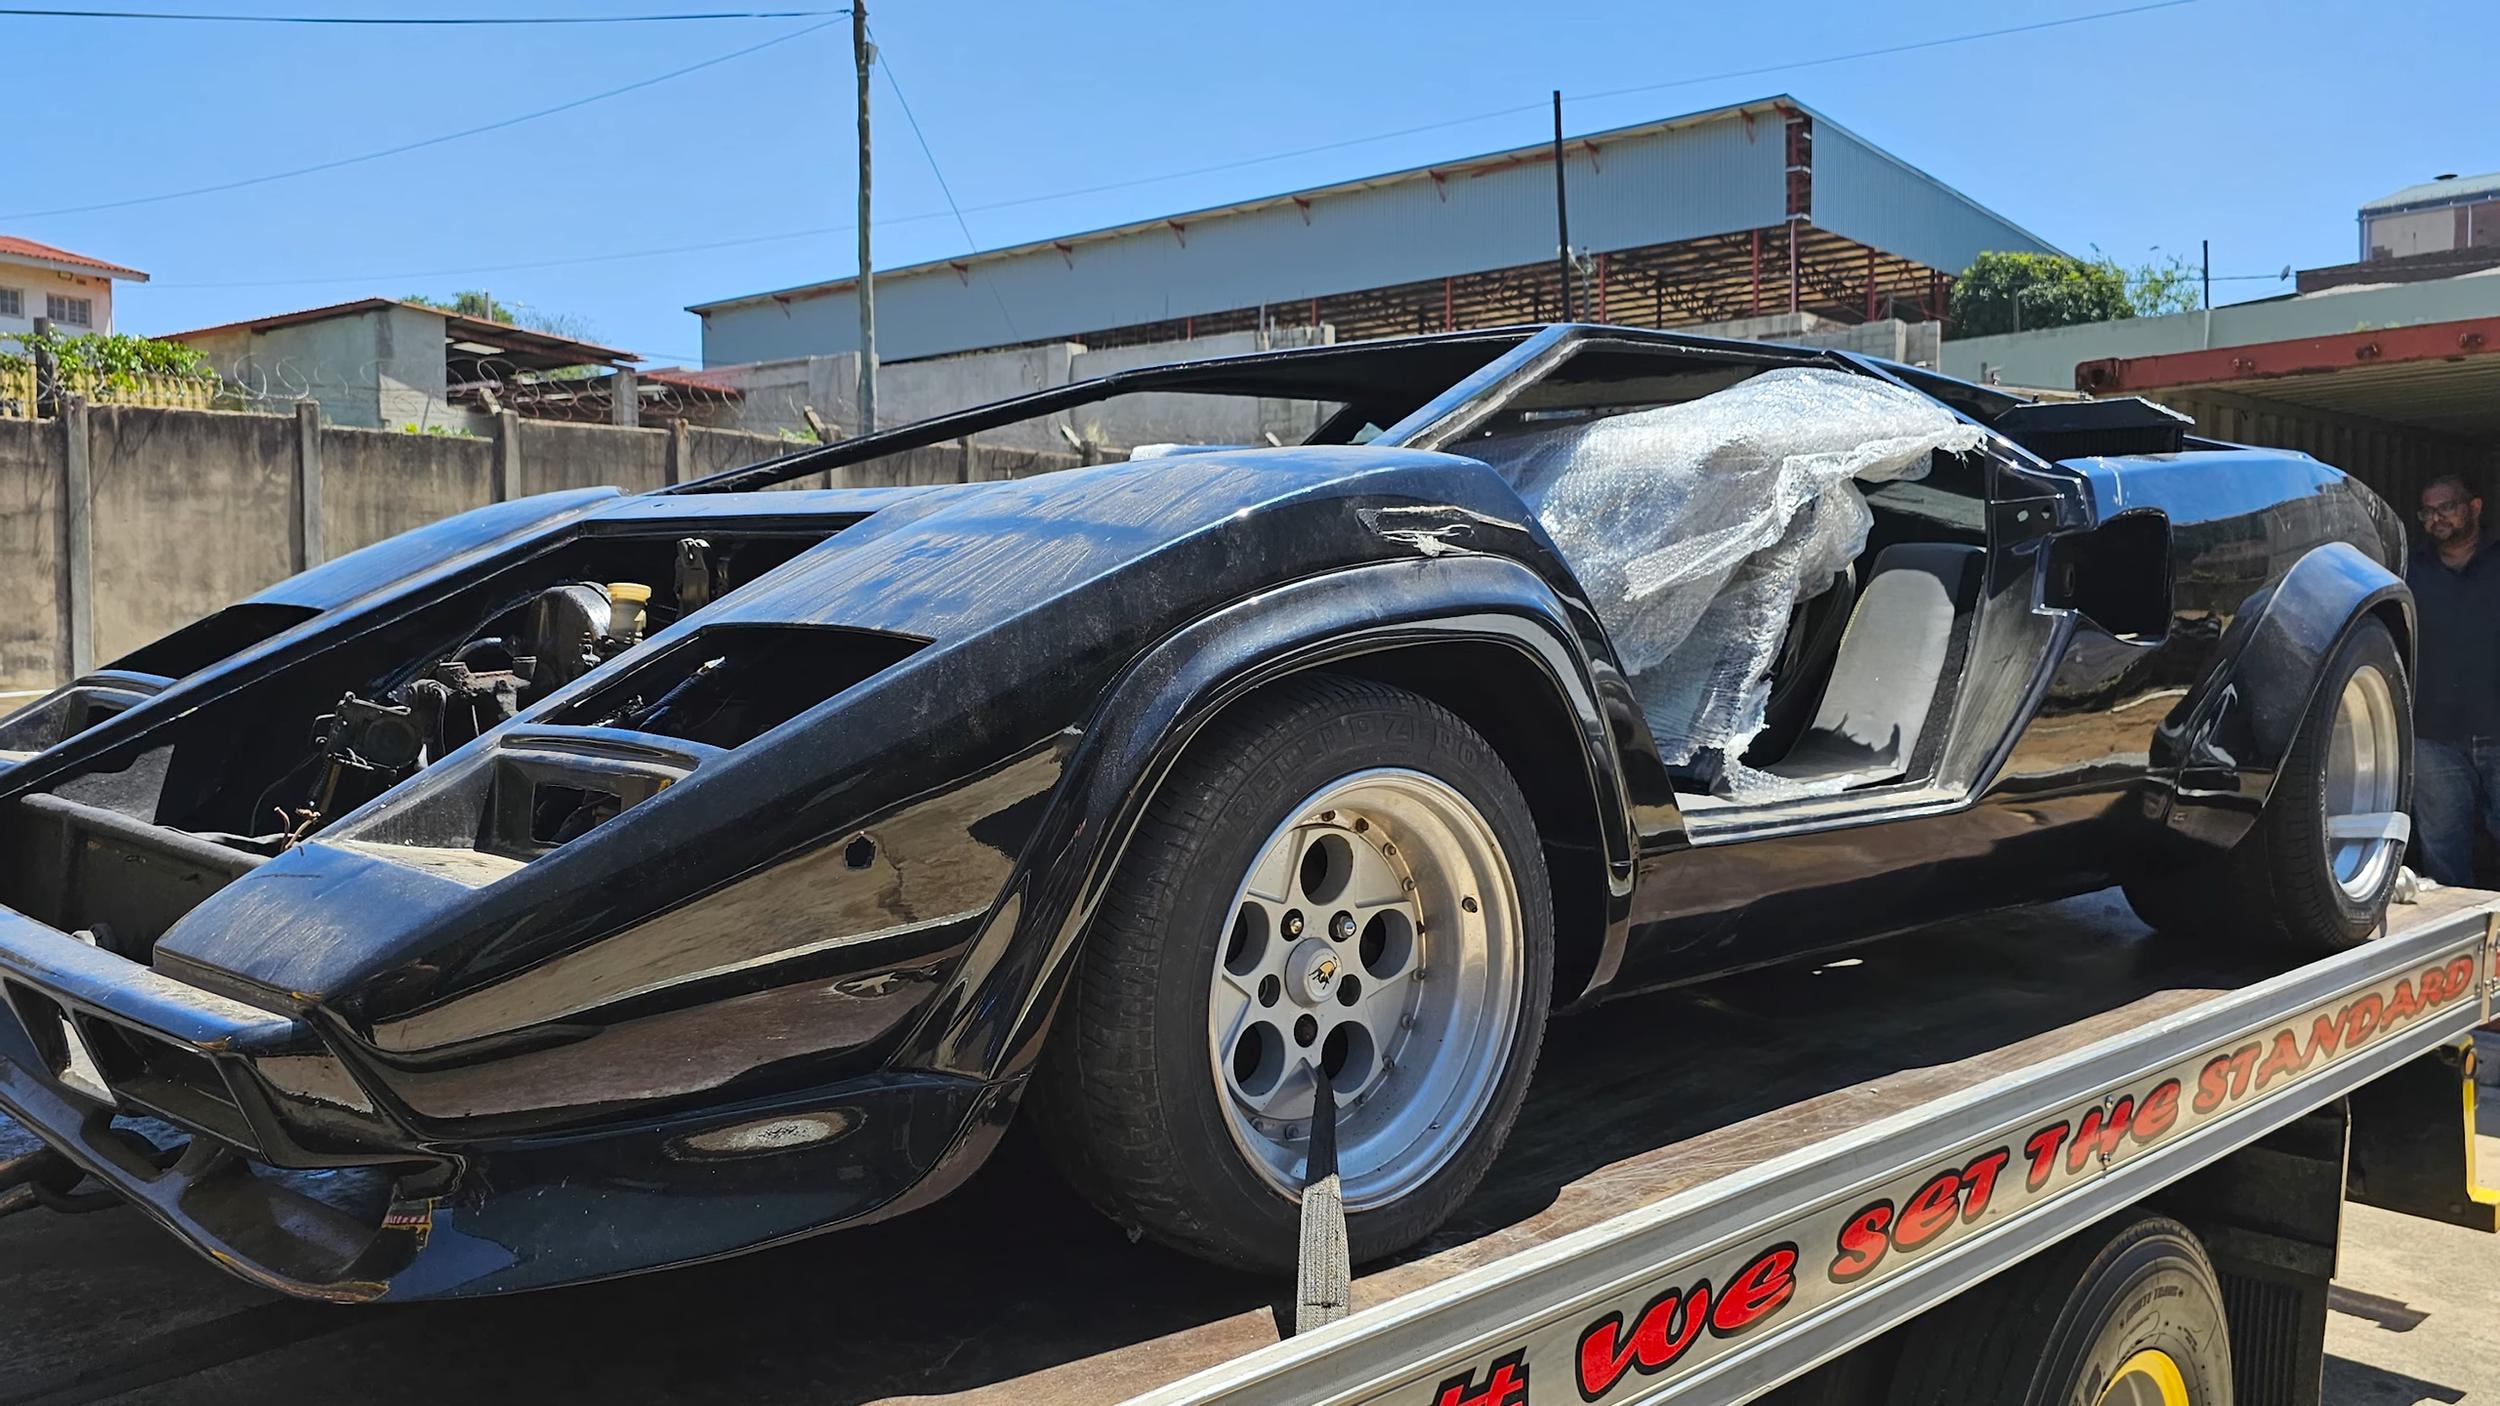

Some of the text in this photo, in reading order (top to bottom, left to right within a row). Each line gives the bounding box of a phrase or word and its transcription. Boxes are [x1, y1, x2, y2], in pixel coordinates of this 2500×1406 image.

[1828, 1145, 2010, 1284] SET
[2024, 1078, 2181, 1193] THE
[2192, 954, 2473, 1114] STANDARD
